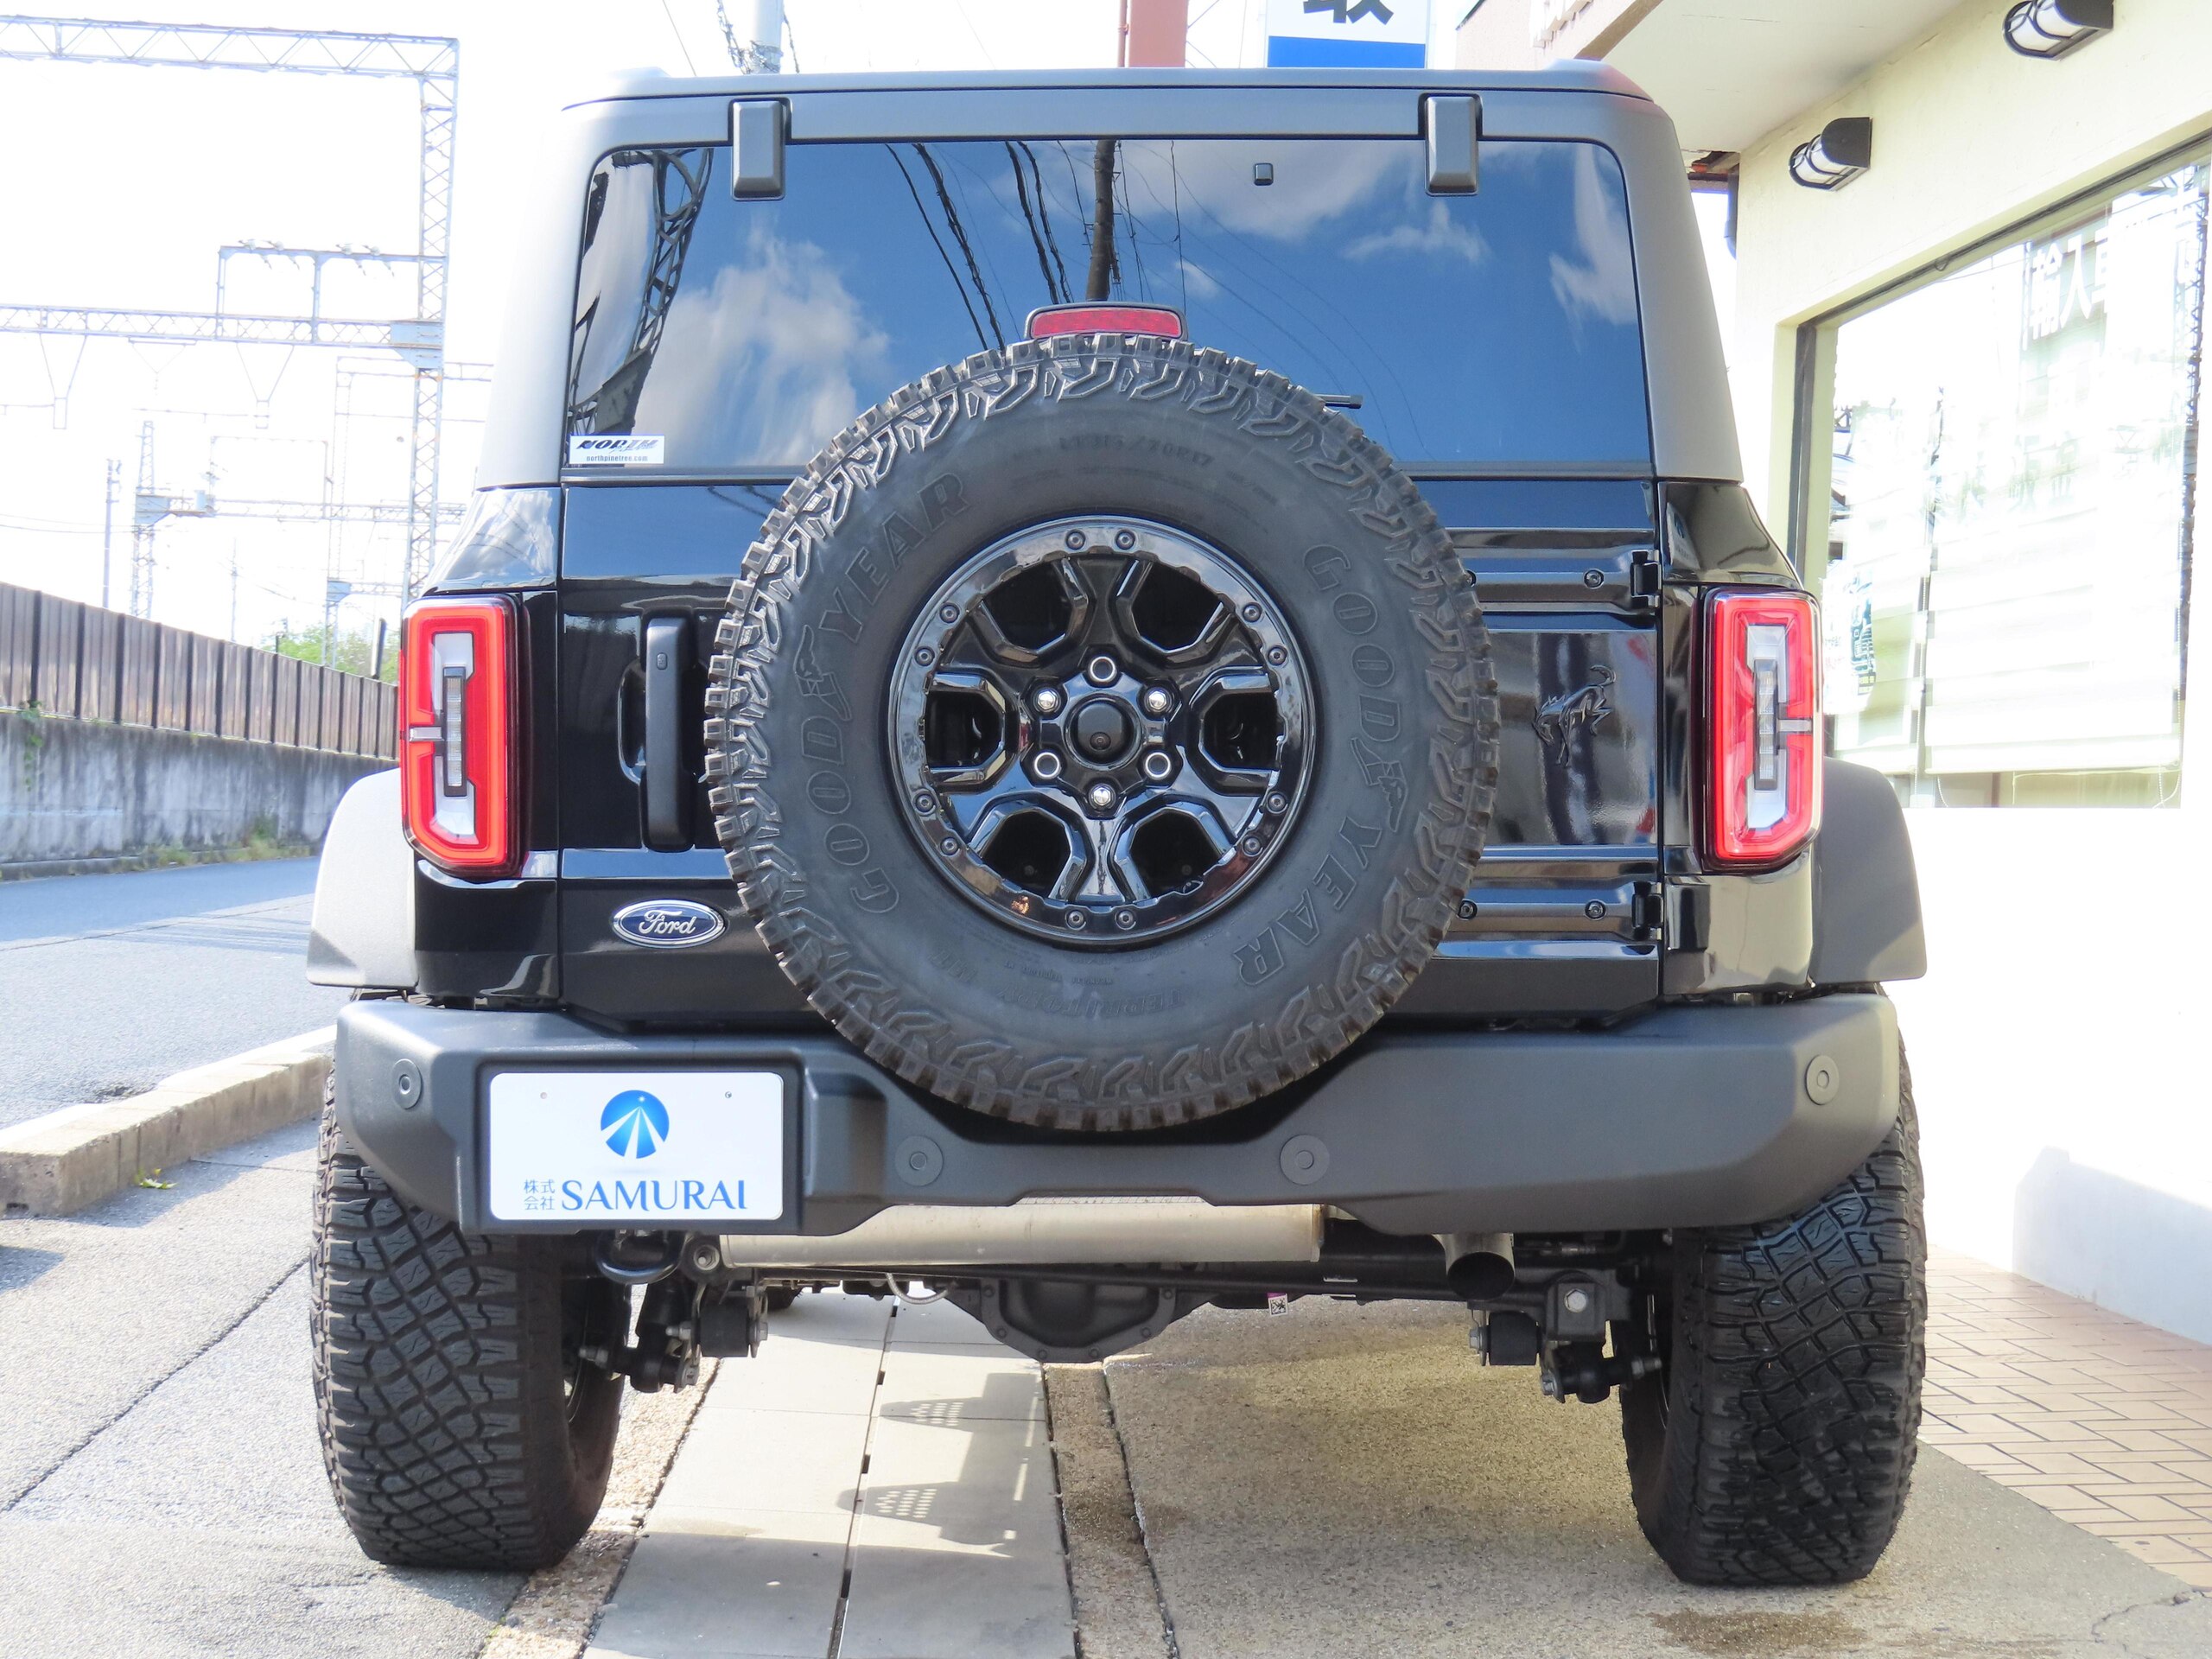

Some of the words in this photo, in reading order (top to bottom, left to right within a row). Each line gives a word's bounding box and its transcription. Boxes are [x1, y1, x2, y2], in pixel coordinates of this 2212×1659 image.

[639, 909, 696, 934] Ford
[524, 1179, 556, 1194] 株式
[562, 1179, 748, 1211] SAMURAI
[524, 1196, 556, 1211] 会社
